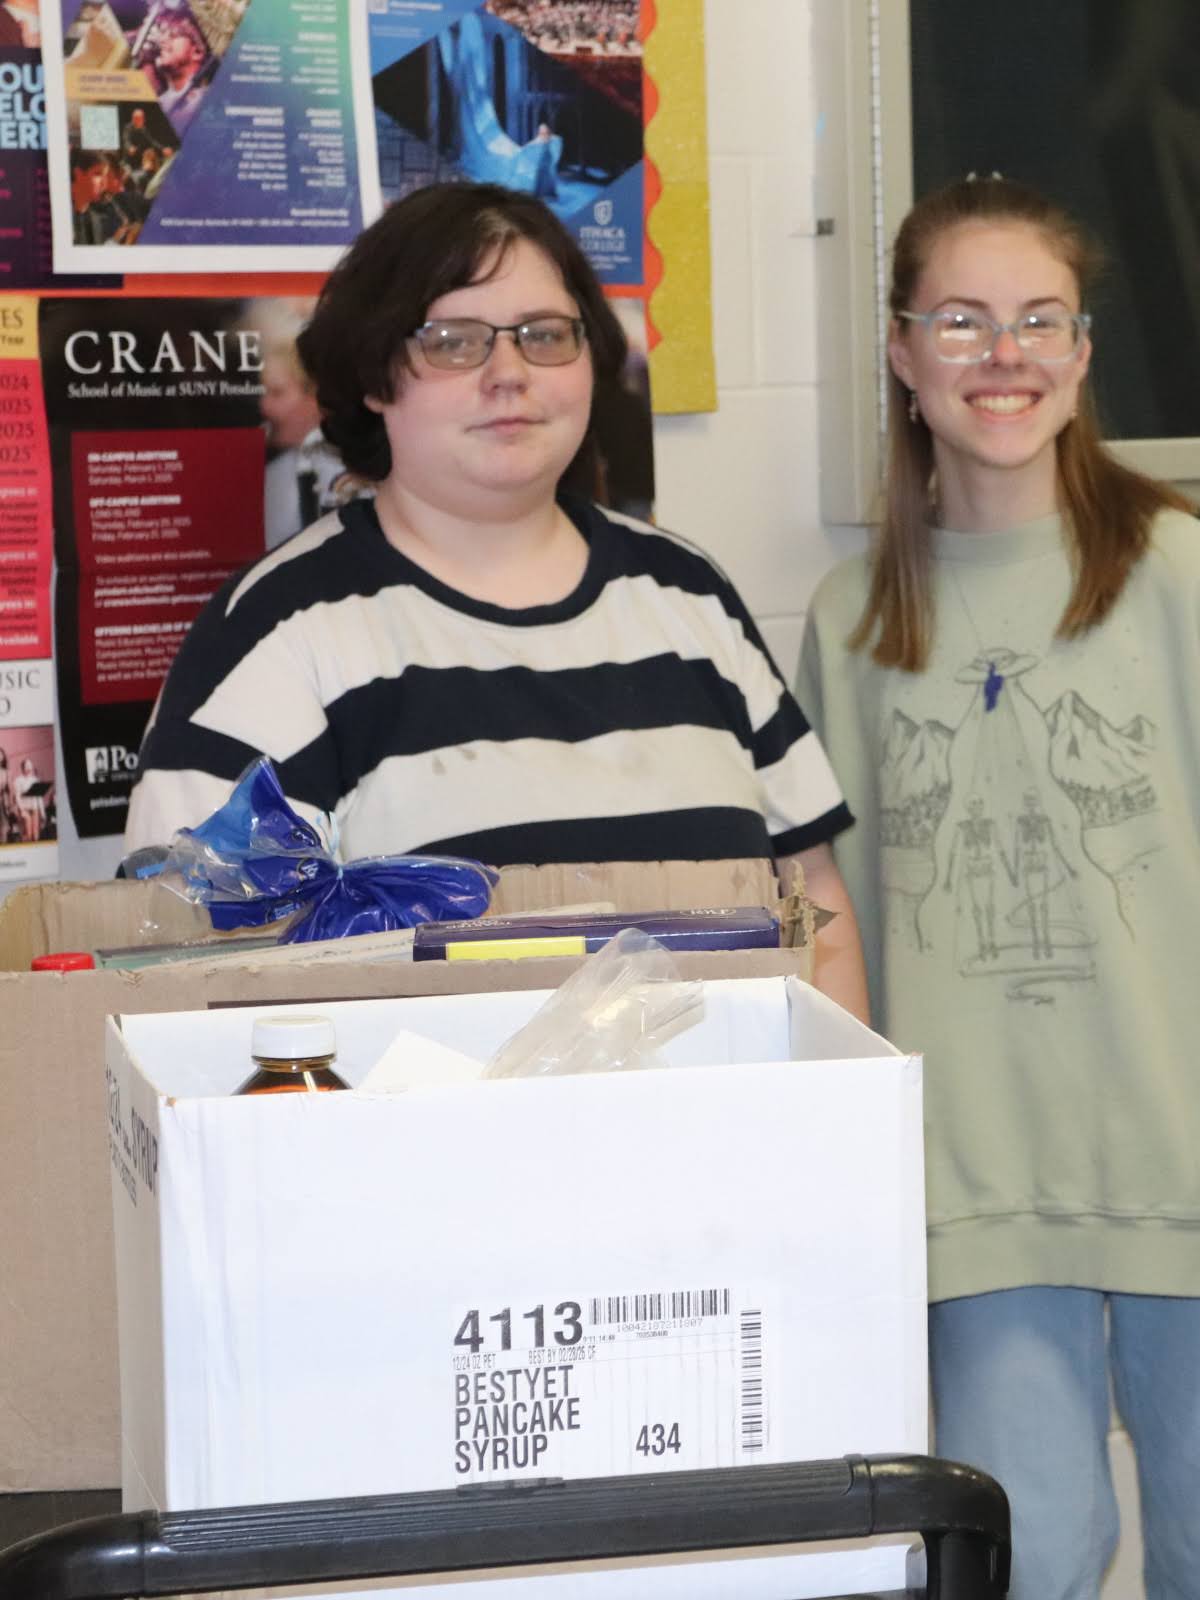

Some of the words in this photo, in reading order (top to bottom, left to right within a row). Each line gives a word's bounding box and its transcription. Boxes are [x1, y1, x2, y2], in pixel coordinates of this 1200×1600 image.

[64, 330, 265, 374] CRANE
[67, 382, 109, 399] School
[111, 382, 125, 397] of
[127, 382, 162, 397] Music
[165, 384, 176, 397] at
[179, 380, 217, 396] SUNY
[220, 380, 267, 395] Potsdam
[131, 1106, 158, 1197] SYRUP
[454, 1301, 583, 1353] 4113
[455, 1364, 574, 1407] BESTYET
[455, 1397, 581, 1441] PANCAKE
[636, 1422, 681, 1457] 434
[455, 1433, 548, 1474] SYRUP
